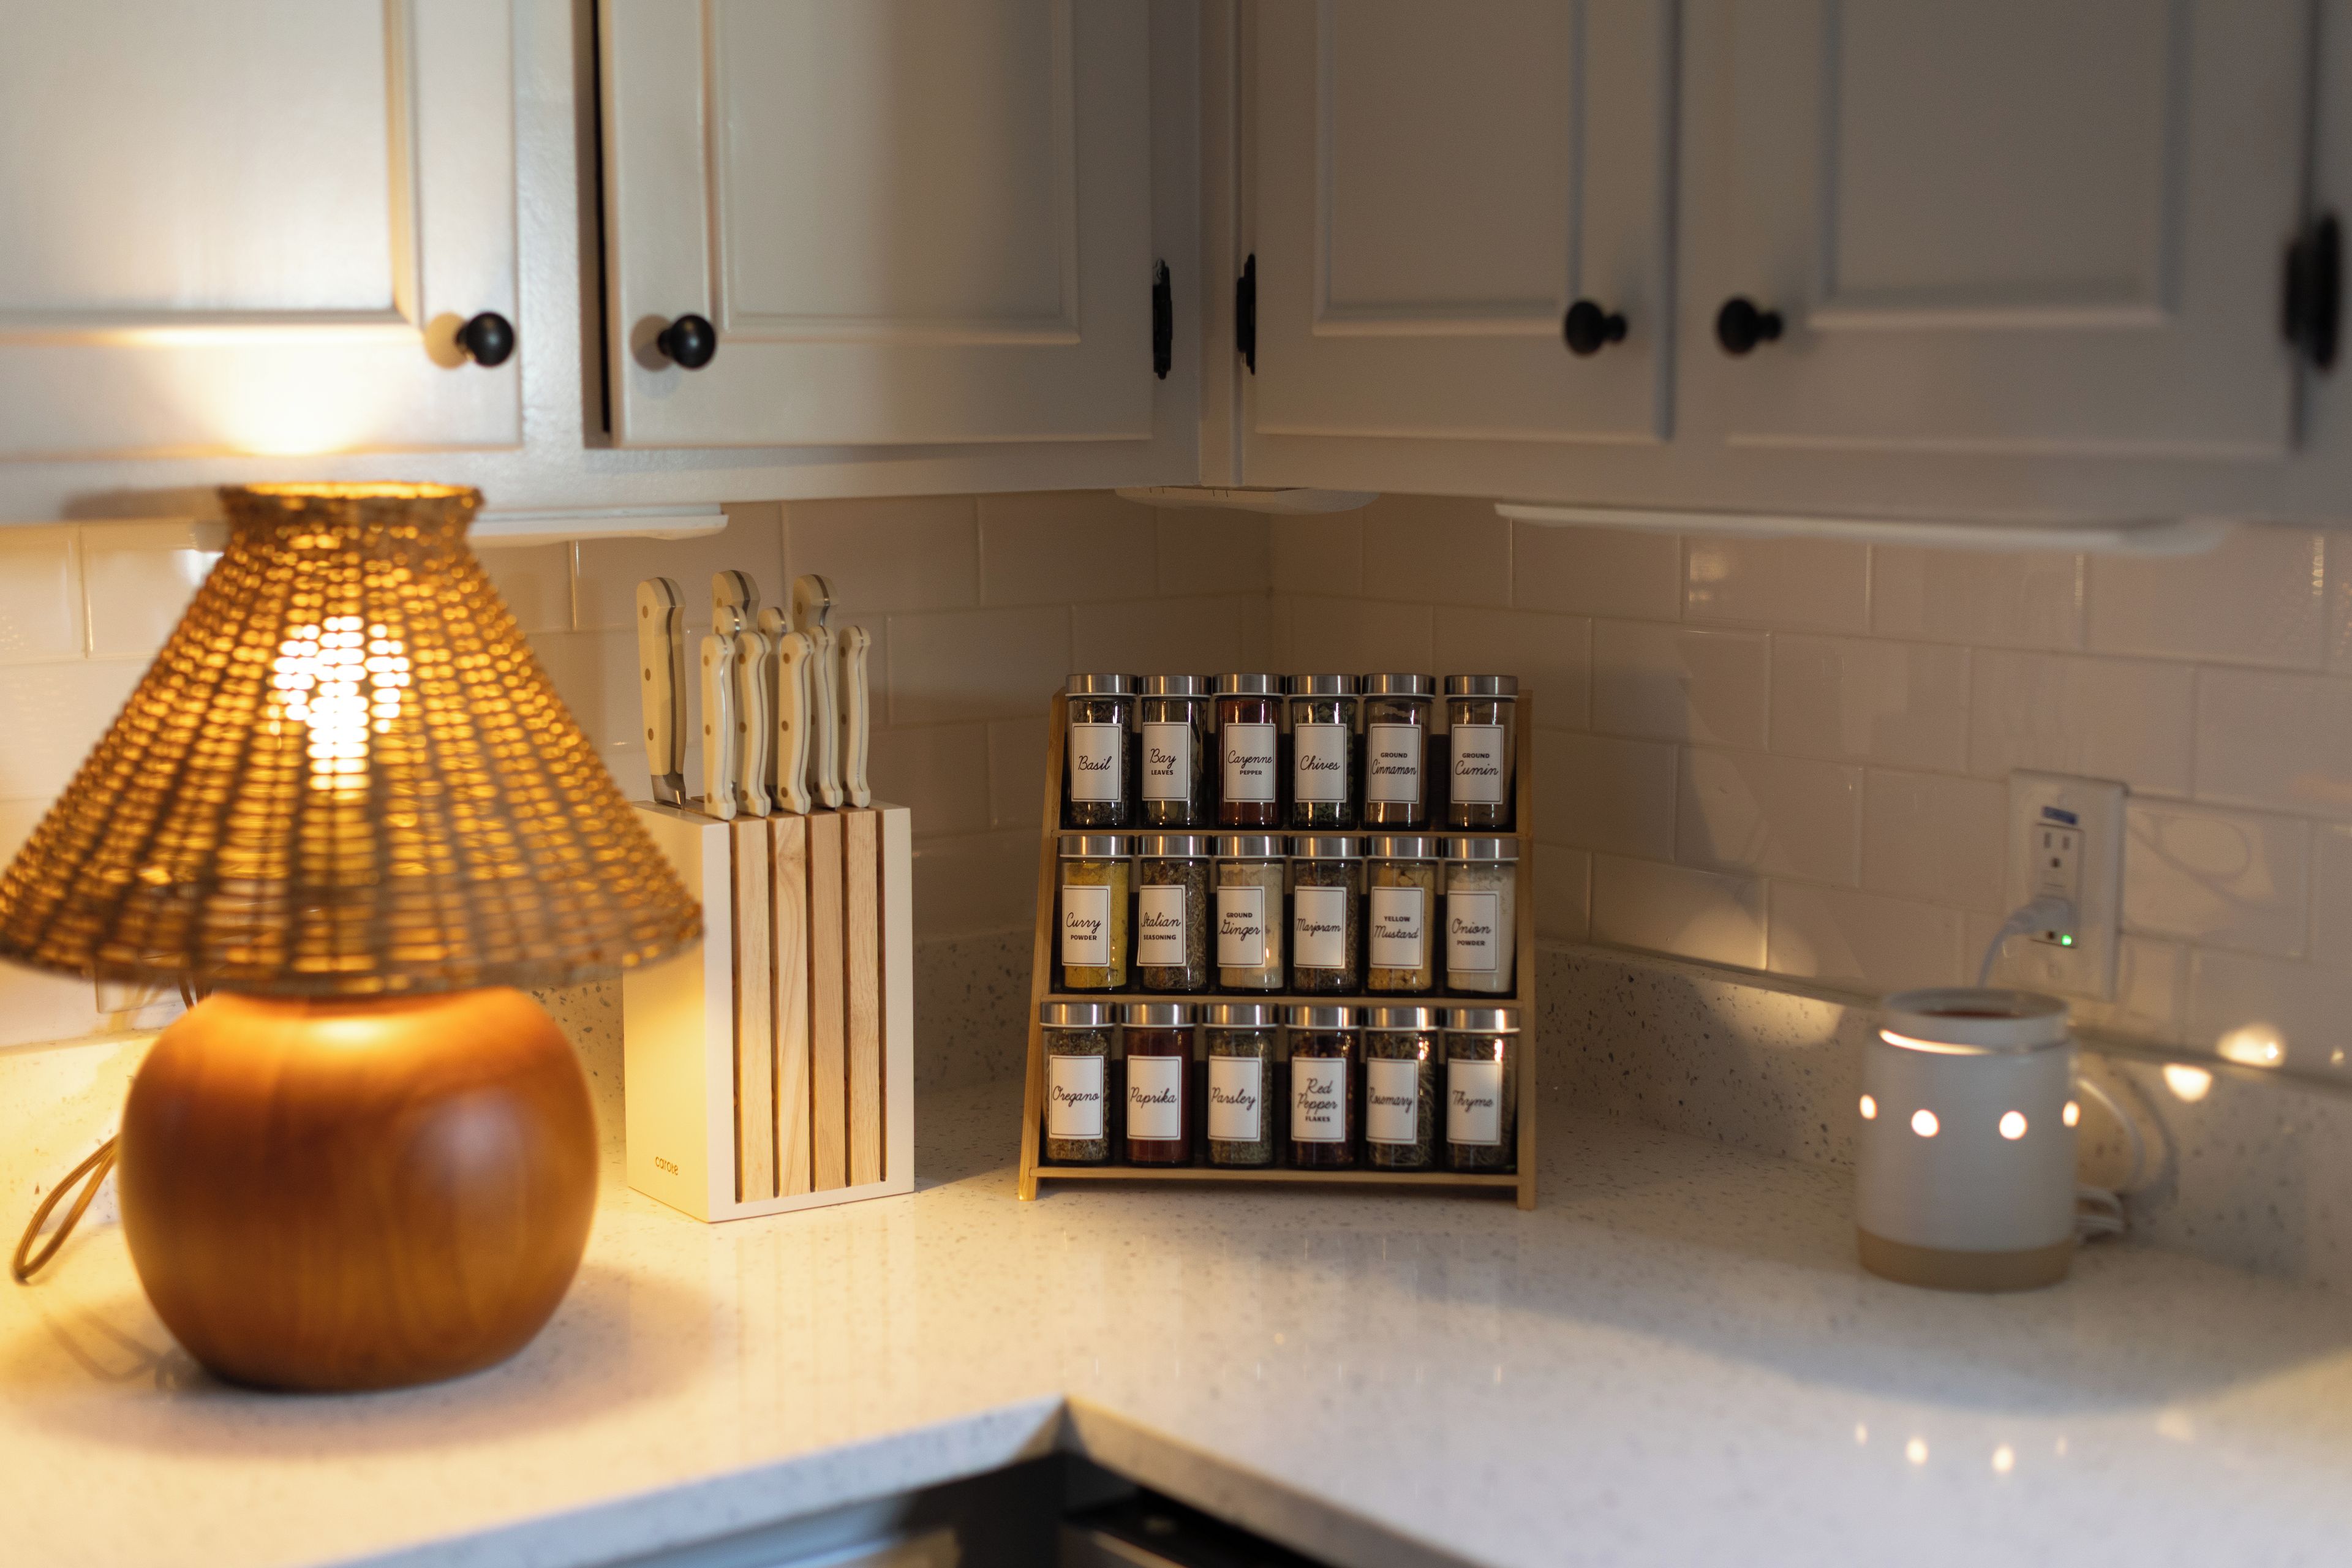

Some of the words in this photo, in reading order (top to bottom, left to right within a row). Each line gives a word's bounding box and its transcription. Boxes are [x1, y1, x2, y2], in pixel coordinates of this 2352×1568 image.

[1077, 755, 1112, 771] Basil
[1150, 748, 1177, 769] Bay
[1228, 750, 1273, 769] Cayenne
[1300, 755, 1341, 771] Chives
[1371, 758, 1417, 775] Cinnamon
[1455, 760, 1499, 776] Cumin
[1066, 912, 1101, 934] Curry
[1141, 912, 1181, 927] Italian
[1297, 918, 1341, 937] Marjoram
[1451, 918, 1491, 935] Onion
[1219, 919, 1261, 941] Ginger
[1374, 925, 1419, 939] Mustard
[1305, 1078, 1333, 1094] Red
[1052, 1085, 1100, 1107] Oregano
[1131, 1087, 1177, 1109] Paprika
[1210, 1087, 1256, 1111] Parsley
[1297, 1092, 1338, 1114] Pepper
[1452, 1090, 1493, 1112] Thyme
[655, 1156, 679, 1176] carote
